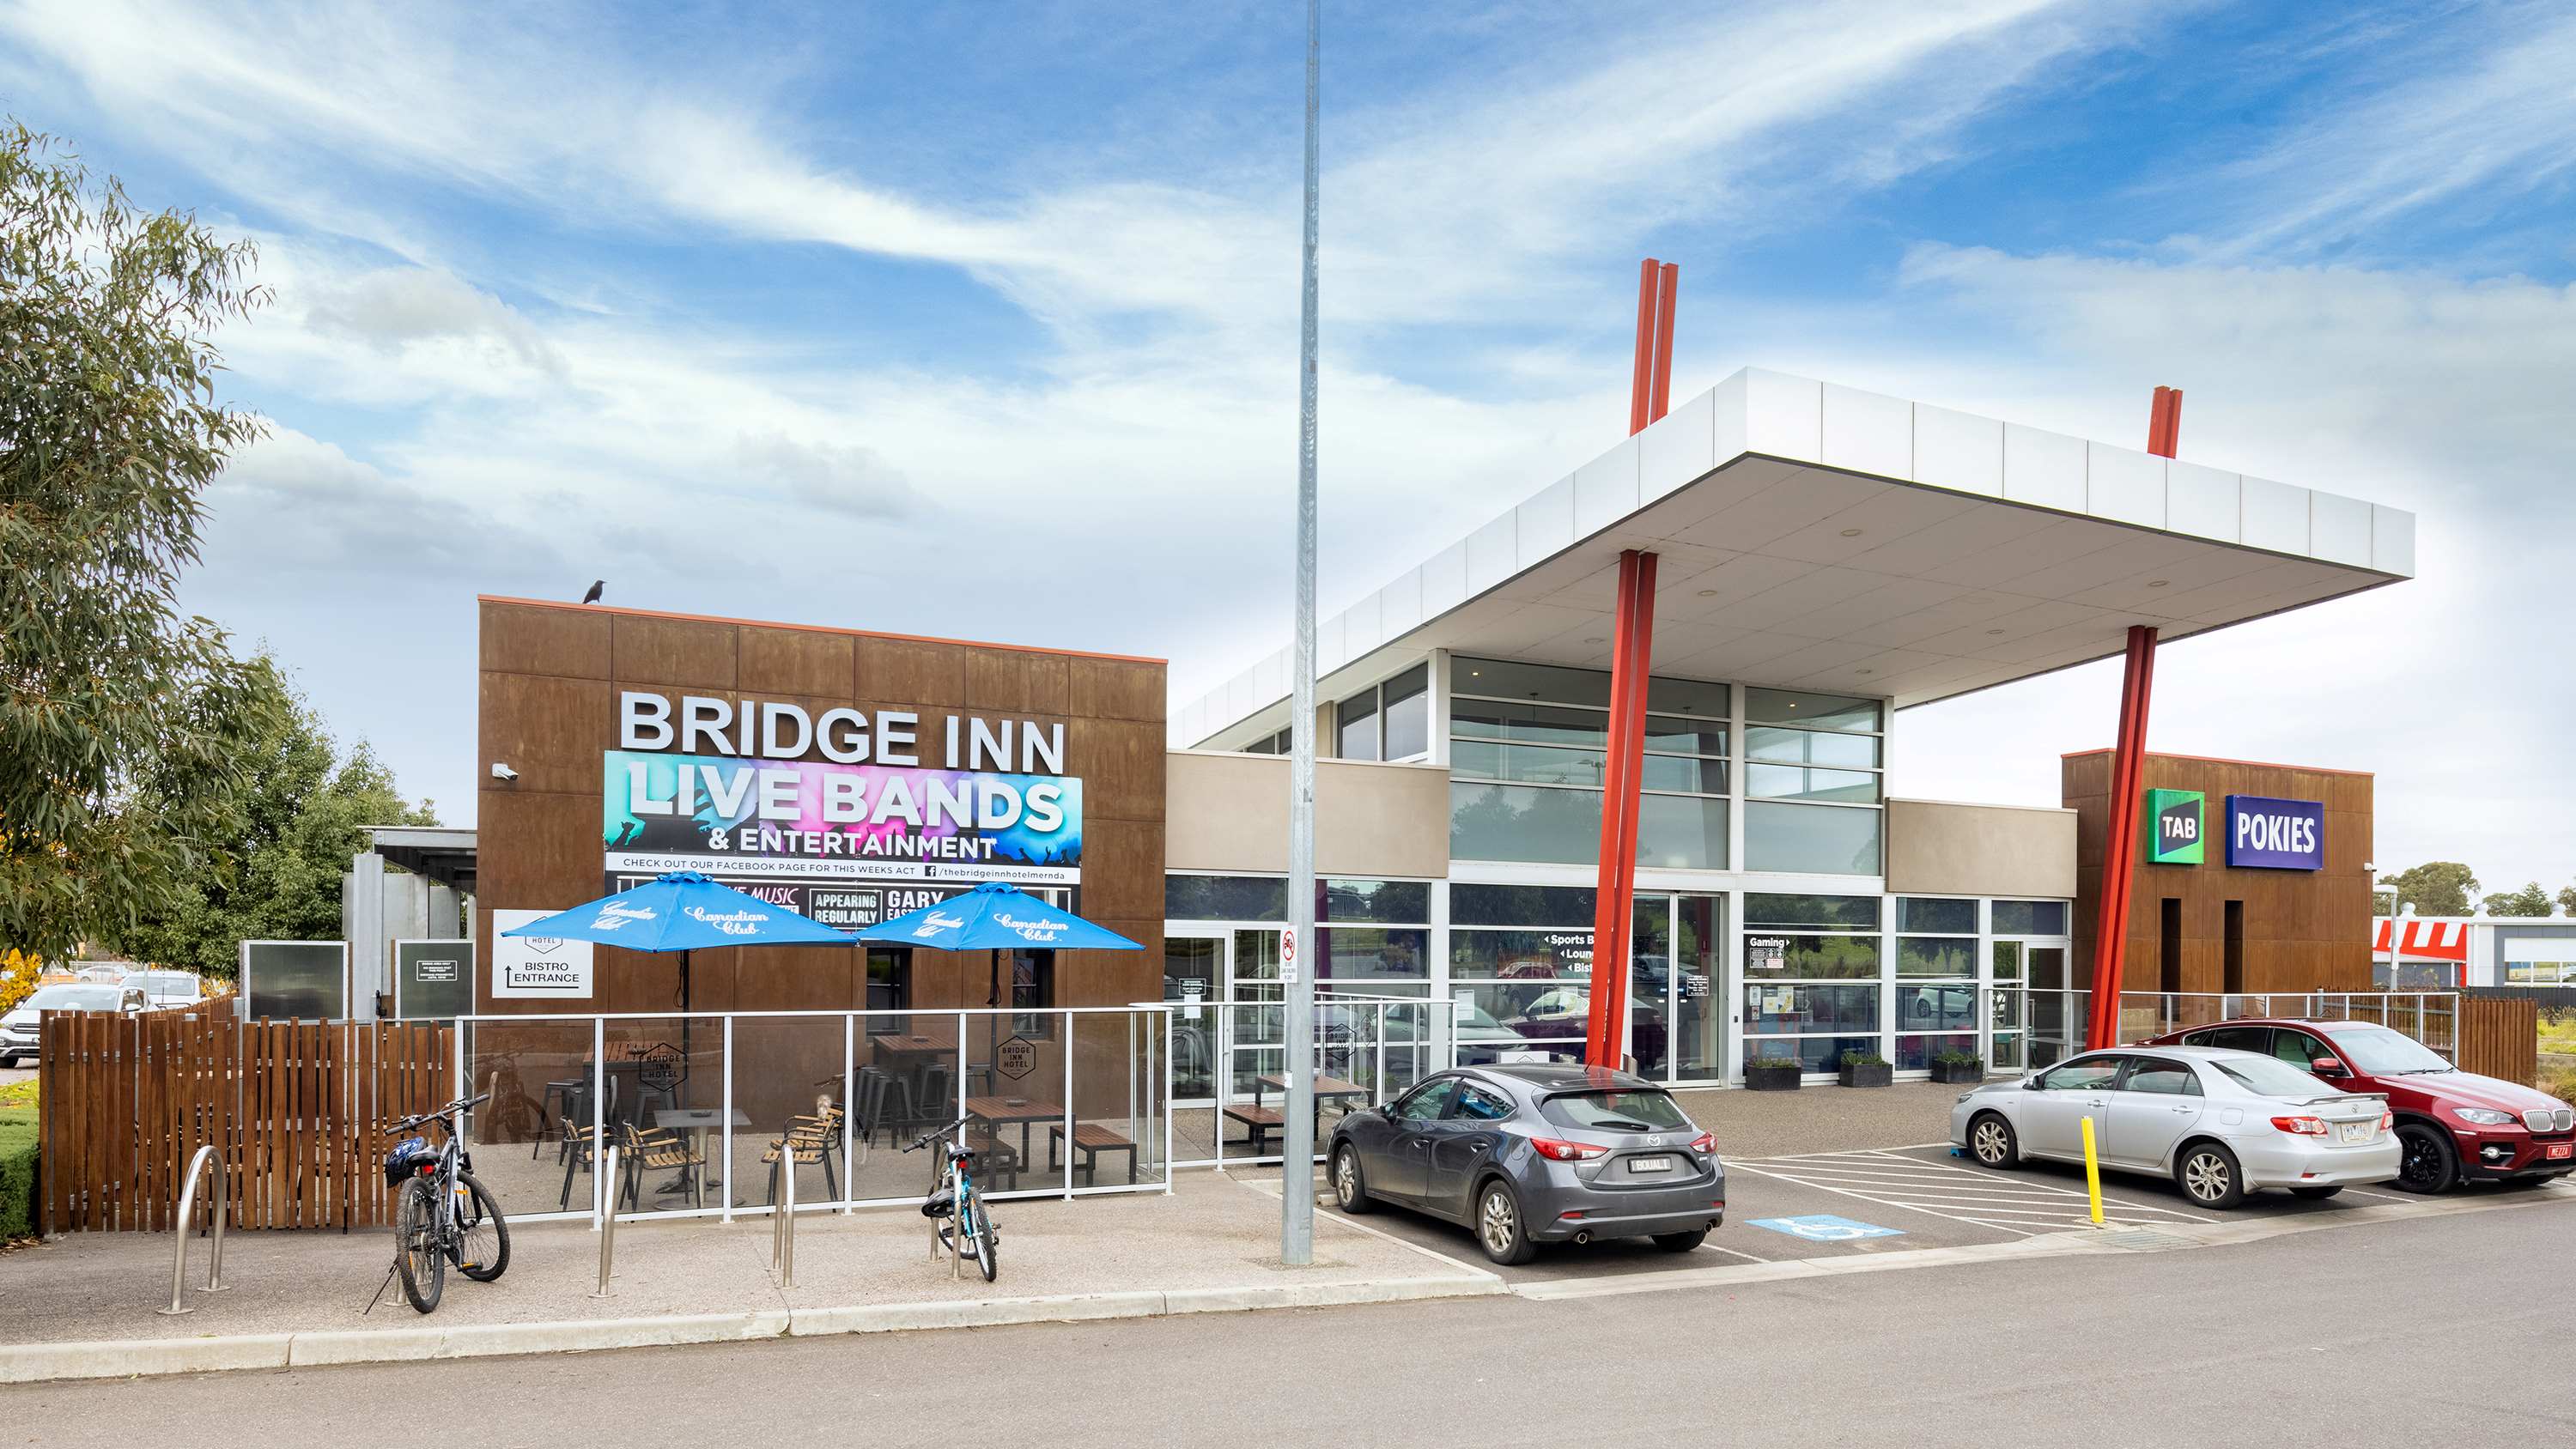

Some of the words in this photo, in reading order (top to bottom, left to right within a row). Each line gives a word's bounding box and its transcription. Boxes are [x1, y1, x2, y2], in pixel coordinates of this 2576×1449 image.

[621, 691, 919, 767] BRIDGE
[946, 715, 1064, 775] INN
[628, 761, 801, 821] LIVE
[823, 773, 1065, 832] BANDS
[2162, 816, 2196, 839] TAB
[2237, 812, 2316, 853] POKIES
[708, 828, 730, 851] &
[740, 828, 996, 859] ENTERTAINMENT
[623, 858, 660, 867] CHECK
[690, 861, 714, 870] OUR
[717, 862, 775, 871] FACEBOOK
[779, 864, 806, 872] PAGE
[831, 864, 855, 873] THIS
[859, 865, 893, 875] WEEKS
[750, 887, 799, 904] MUSIC
[816, 894, 878, 908] APPEARING
[888, 890, 945, 908] GARY
[684, 906, 769, 922] Canadian
[815, 909, 878, 924] REGULARLY
[993, 913, 1069, 931] Canadian
[1551, 935, 1585, 946] Sports
[1750, 937, 1784, 948] Gaming
[525, 962, 568, 971] BISTRO
[514, 973, 580, 982] ENTRANCE
